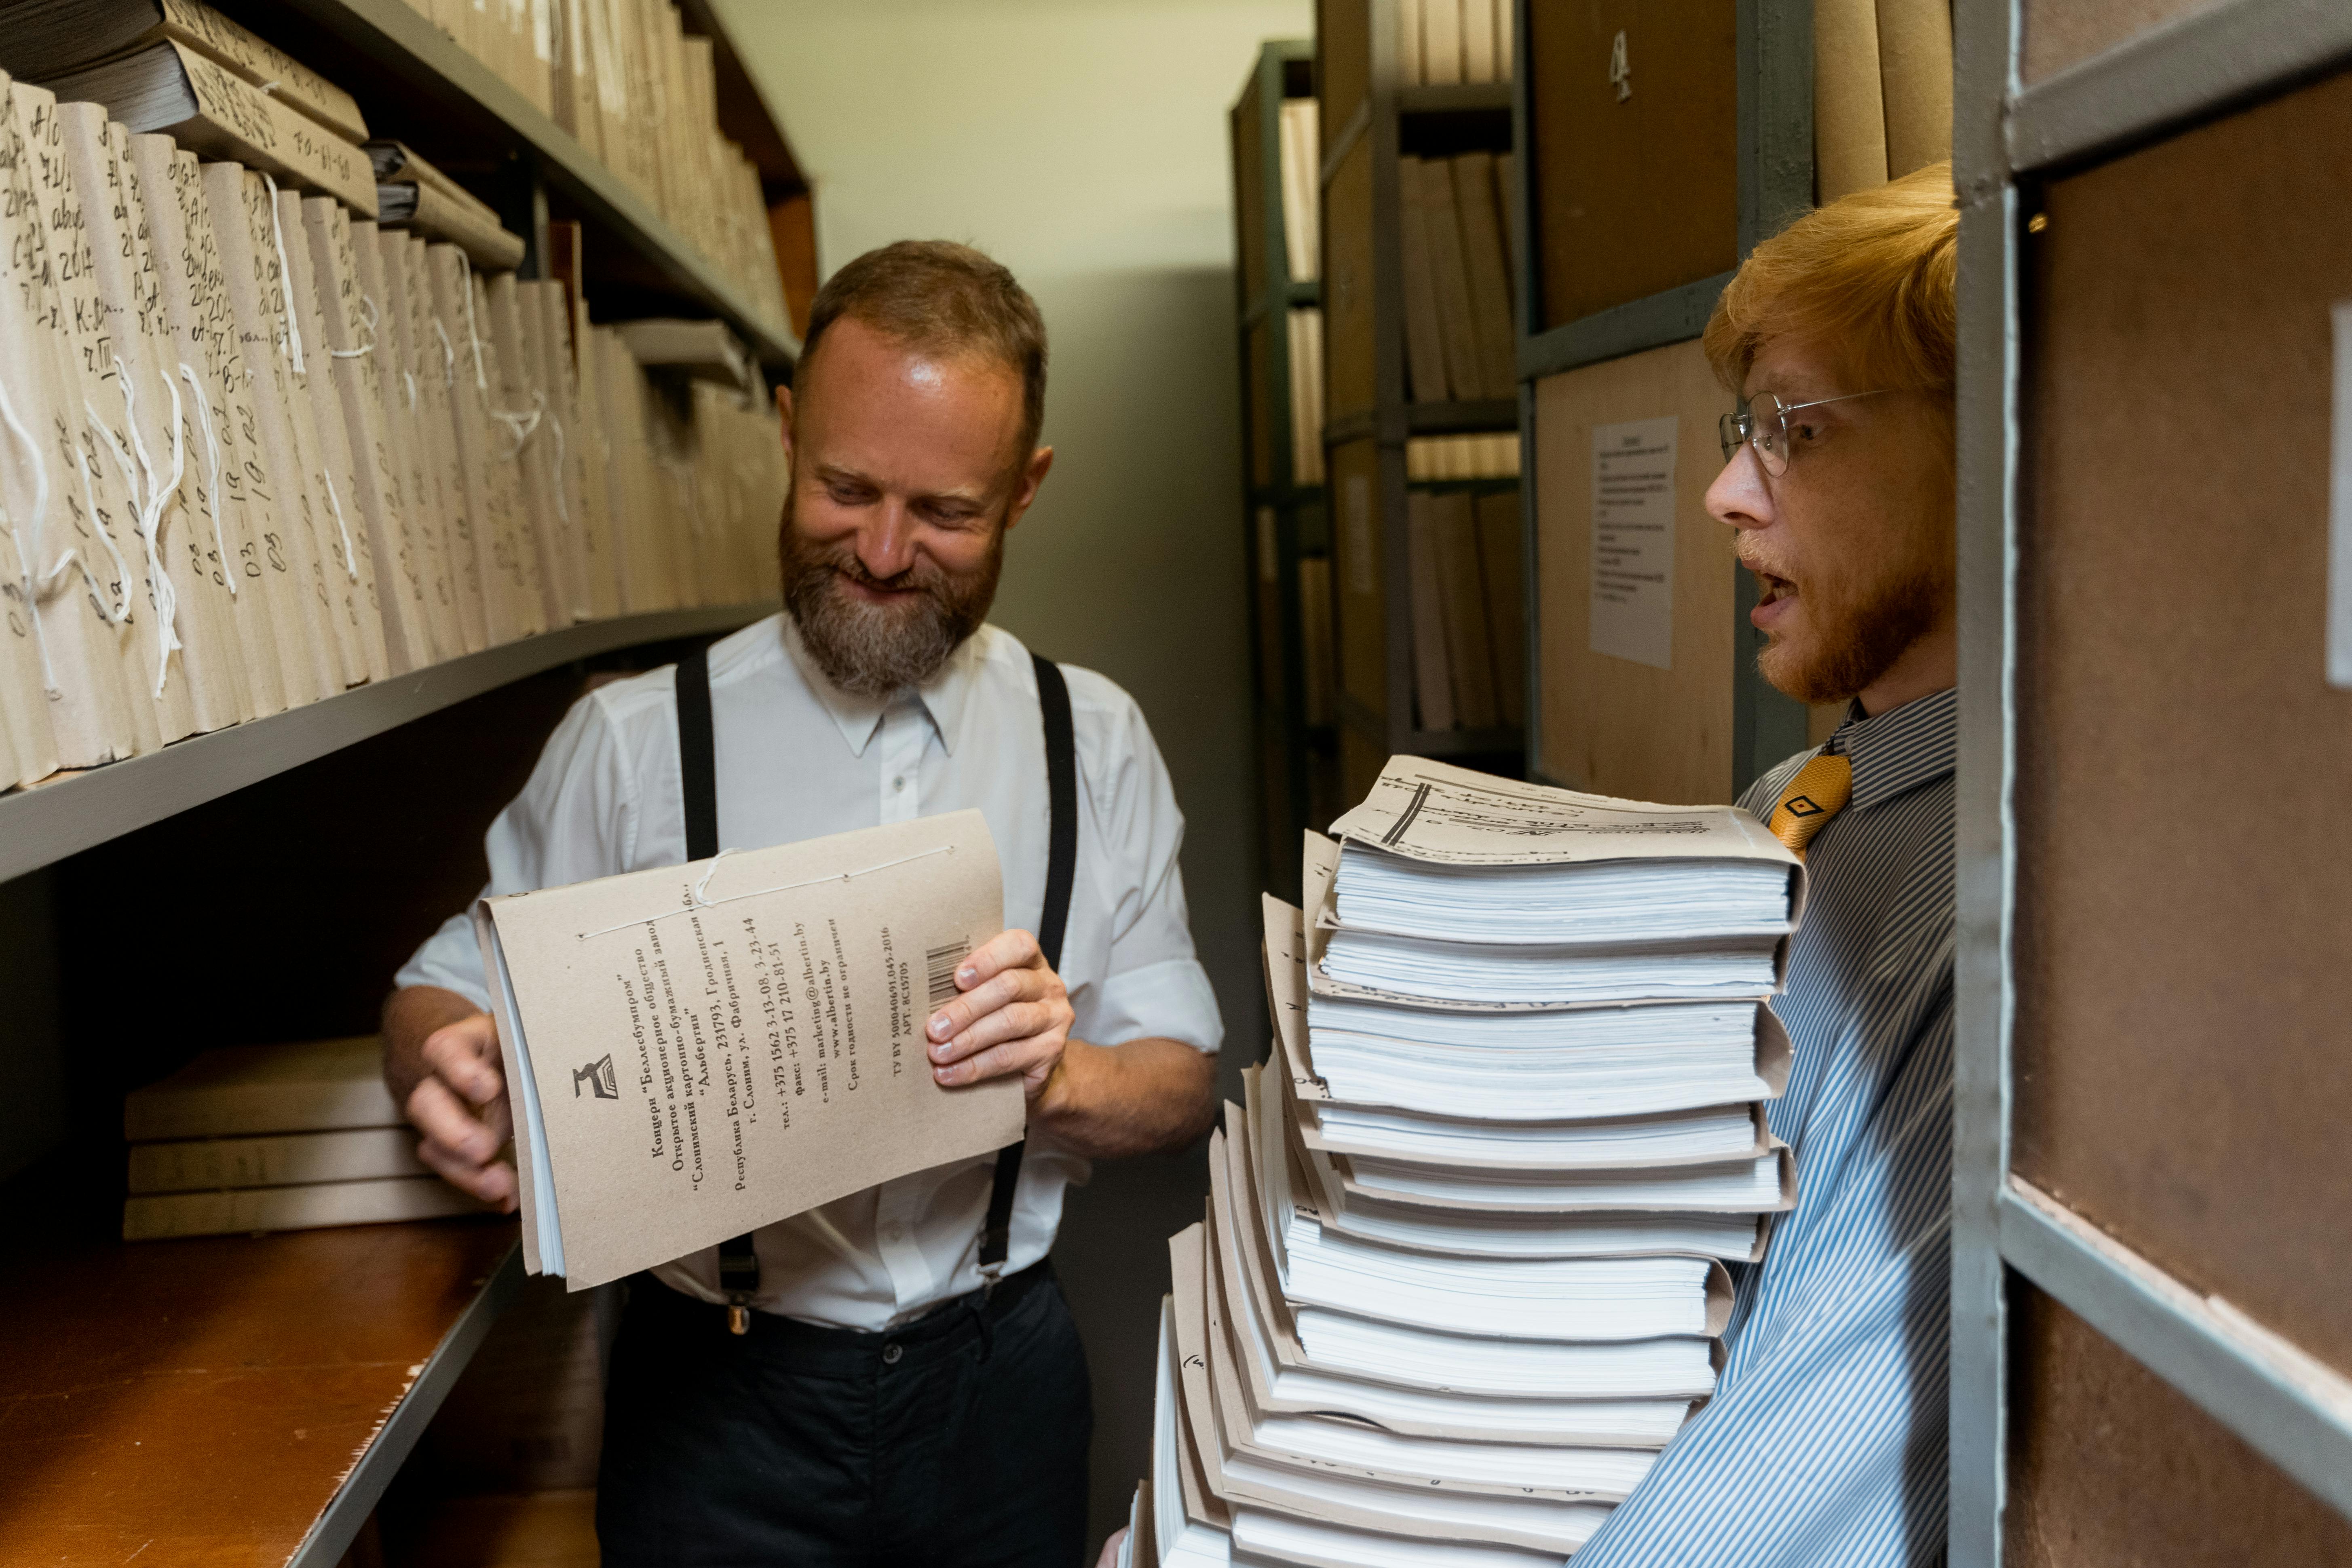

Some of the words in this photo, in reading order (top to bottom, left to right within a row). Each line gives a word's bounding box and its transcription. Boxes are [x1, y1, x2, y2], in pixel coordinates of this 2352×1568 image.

[645, 919, 662, 955] завод
[691, 916, 718, 996] Гродненская
[742, 918, 765, 969] 3-23-44
[828, 919, 848, 981] ограничен
[635, 948, 657, 1009] общество
[721, 951, 742, 1028] Фабричная,
[758, 973, 777, 1028] 3-13-08,
[767, 943, 791, 1005] 210-81-51
[793, 922, 826, 1059] marketing@albertin.by
[842, 986, 850, 999] не
[654, 960, 693, 1097] картонно-бумажный
[709, 999, 729, 1049] 231793,
[781, 1010, 794, 1023] 17
[819, 960, 840, 1059] www.albertin.by
[845, 1003, 856, 1056] годности
[652, 1015, 675, 1099] акционерное
[738, 1033, 750, 1052] ул.
[768, 1031, 783, 1062] 1562
[784, 1027, 798, 1058] +375
[724, 1053, 739, 1118] Беларусь,
[742, 1055, 755, 1110] Слоним,
[773, 1065, 786, 1097] +375
[793, 1063, 805, 1096] факс:
[816, 1063, 829, 1103] e-mail:
[848, 1059, 860, 1091] Срок
[648, 1097, 664, 1158] Концерн
[669, 1104, 684, 1171] Открытое
[750, 1113, 757, 1124] г.
[781, 1102, 790, 1130] тел.:
[733, 1120, 746, 1191] Республика
